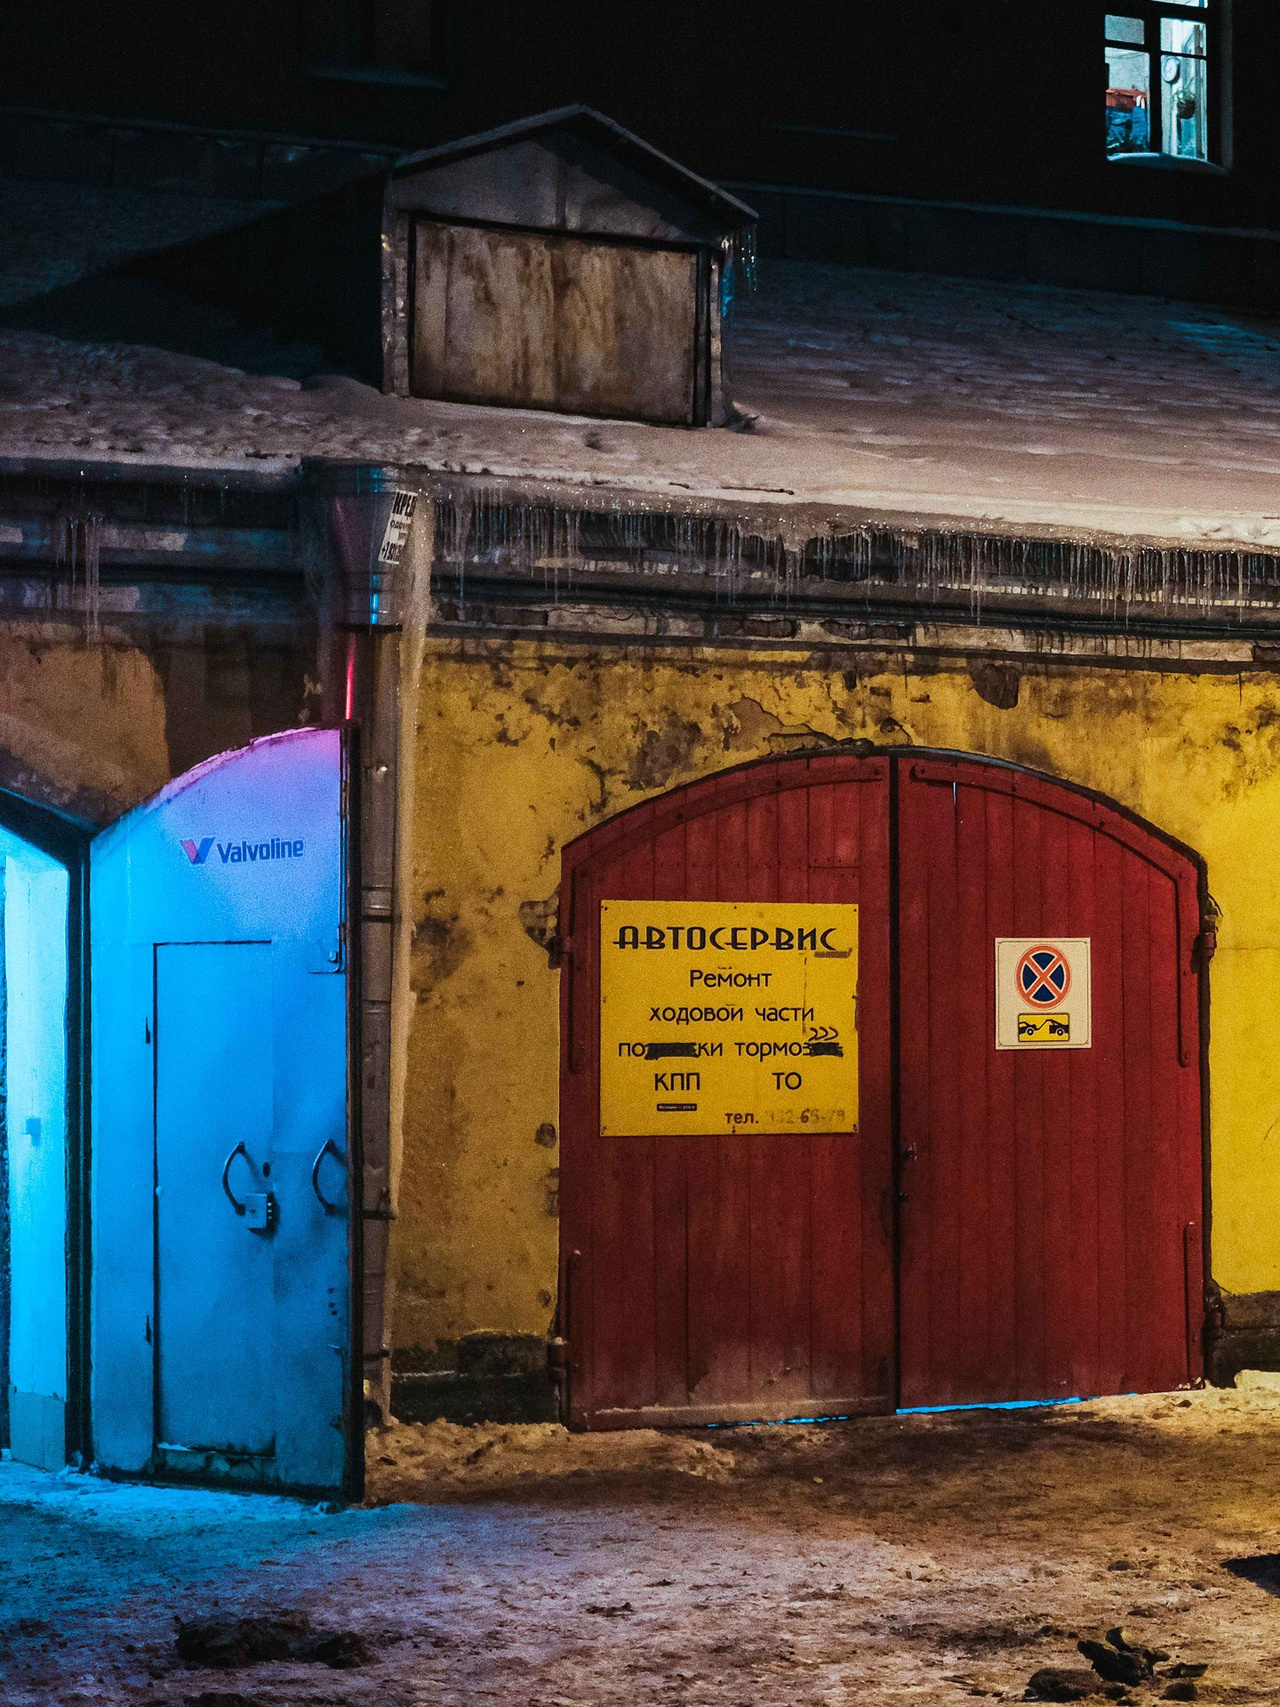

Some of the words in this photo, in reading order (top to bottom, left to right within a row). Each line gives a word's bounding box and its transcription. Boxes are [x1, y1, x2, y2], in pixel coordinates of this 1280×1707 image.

[216, 838, 304, 864] Valvoline
[613, 926, 835, 950] АВТОСЕРВИС
[691, 970, 771, 987] Ремонт
[755, 1008, 813, 1021] части
[655, 1073, 700, 1091] КПП
[772, 1072, 802, 1090] ТО
[725, 1112, 759, 1124] тел.
